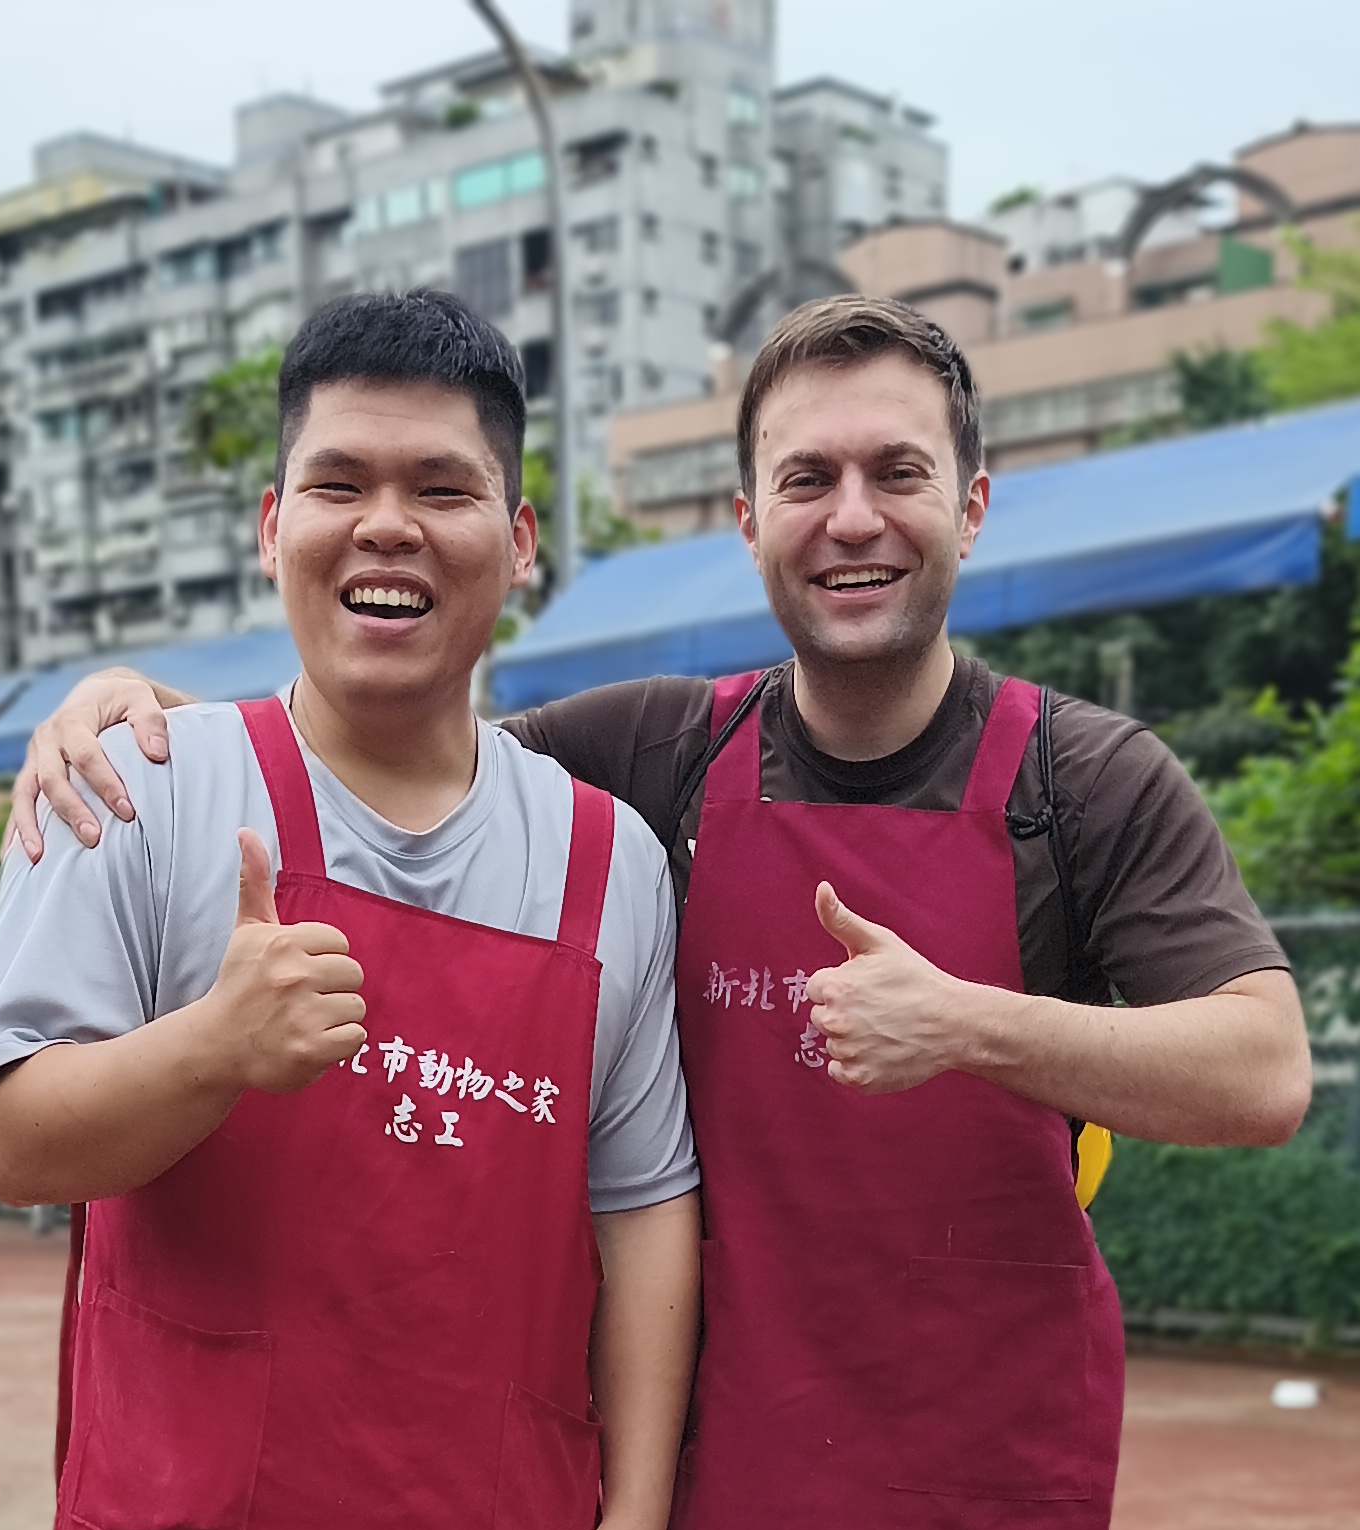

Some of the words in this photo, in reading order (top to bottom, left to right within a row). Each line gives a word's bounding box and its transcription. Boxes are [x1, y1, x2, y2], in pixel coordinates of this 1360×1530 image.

[702, 960, 811, 1014] 新北市
[794, 1021, 829, 1069] 志
[383, 1092, 465, 1148] 志工
